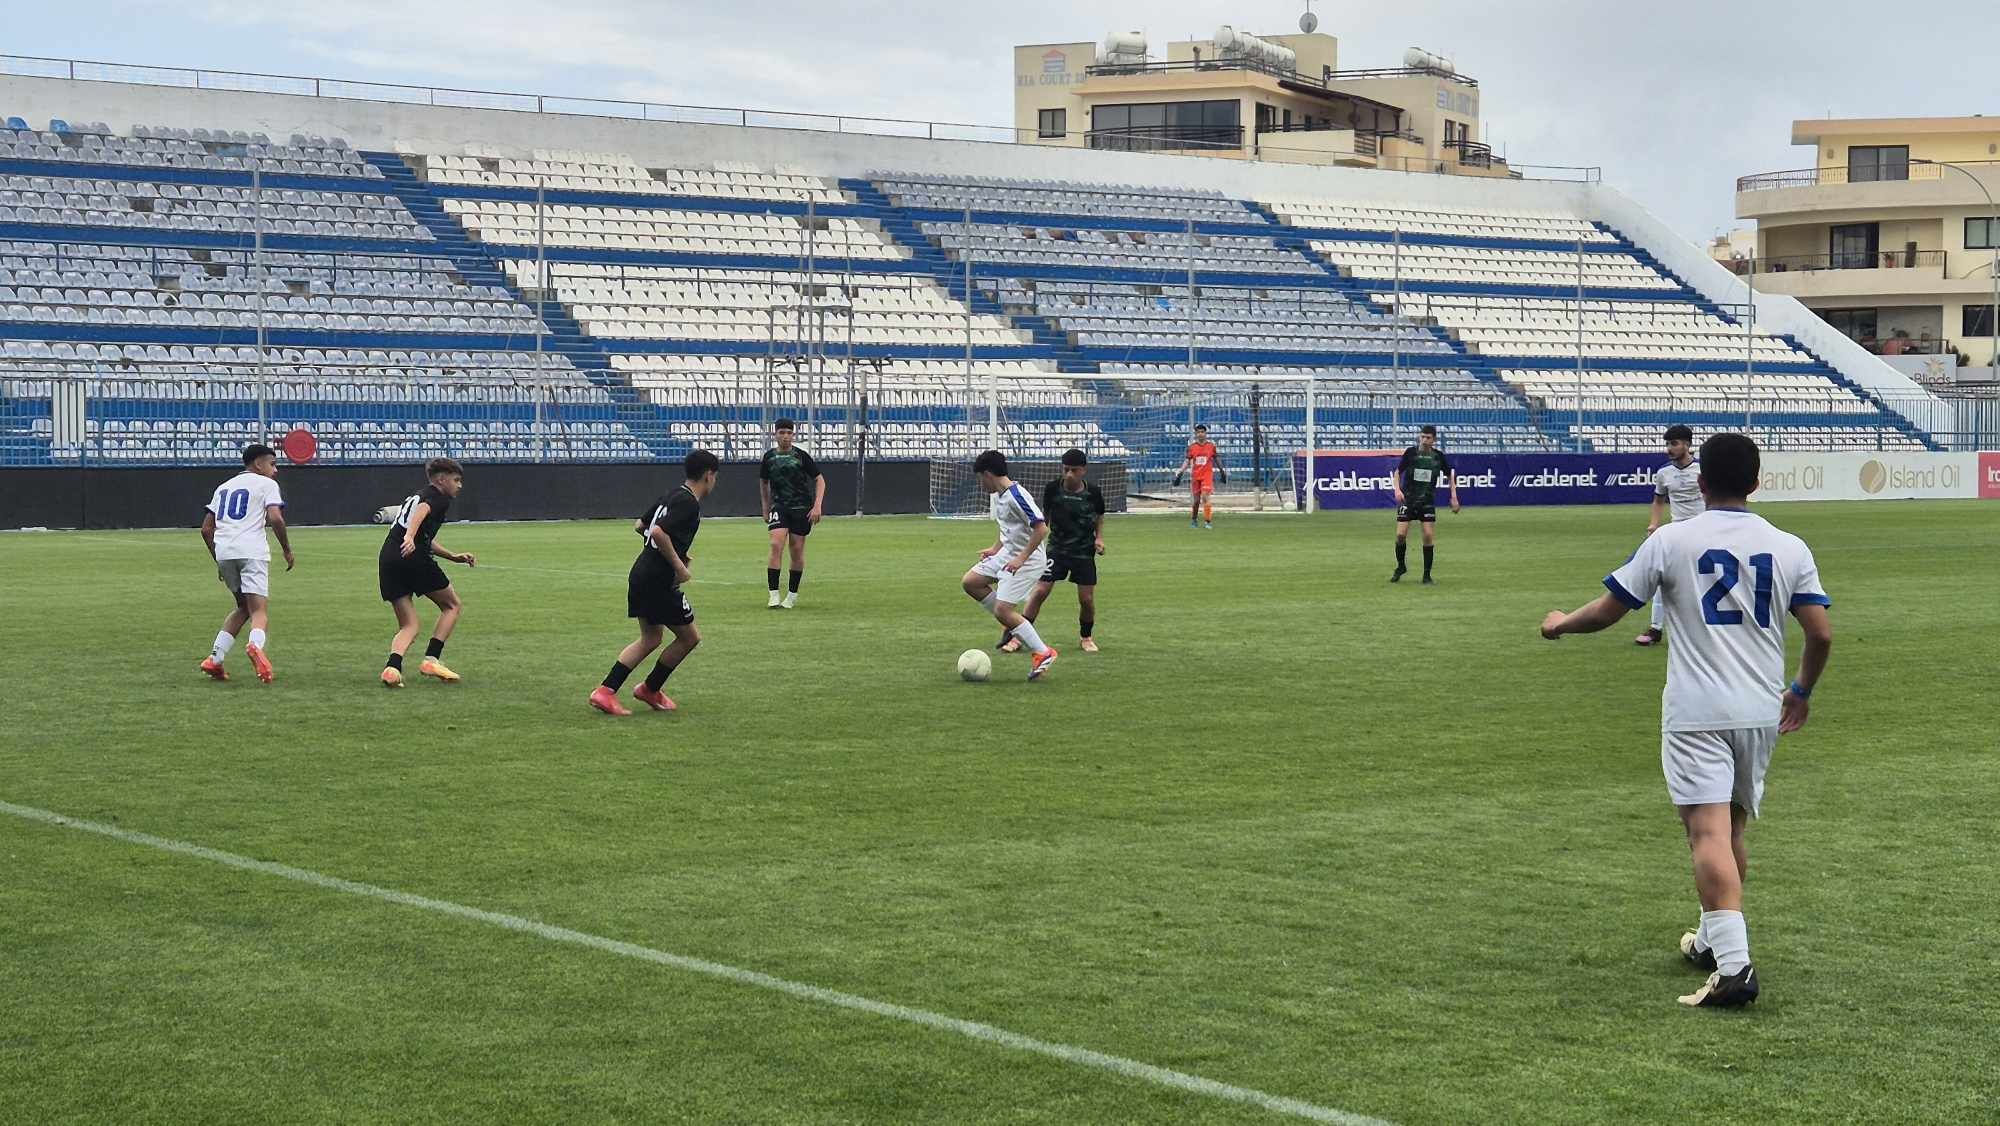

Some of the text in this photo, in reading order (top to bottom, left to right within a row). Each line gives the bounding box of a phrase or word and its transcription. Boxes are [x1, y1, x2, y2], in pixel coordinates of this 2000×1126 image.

[1523, 467, 1597, 487] cablenet
[1760, 465, 1824, 490] land Oil
[1890, 465, 1960, 489] Island Oil
[217, 488, 250, 521] 10
[1697, 549, 1773, 629] 21
